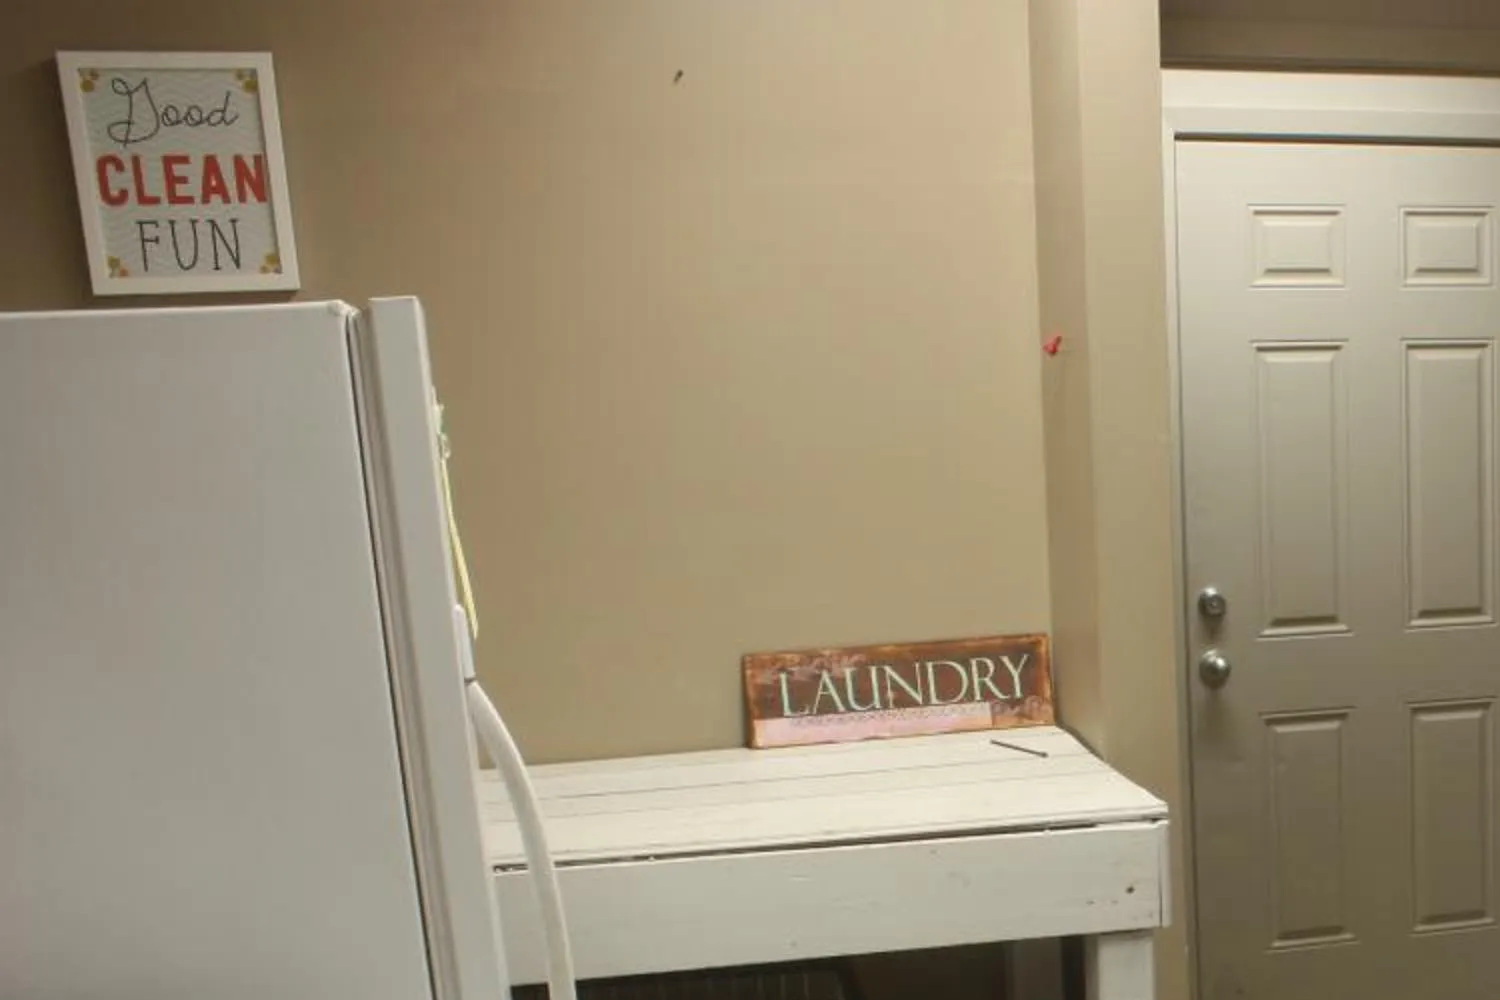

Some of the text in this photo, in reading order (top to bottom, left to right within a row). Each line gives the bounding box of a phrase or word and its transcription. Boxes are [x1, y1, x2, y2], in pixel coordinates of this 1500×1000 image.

[107, 77, 239, 147] Good
[95, 153, 268, 206] CLEAN
[136, 218, 242, 272] FUN
[779, 653, 1030, 718] LAUNDRY
